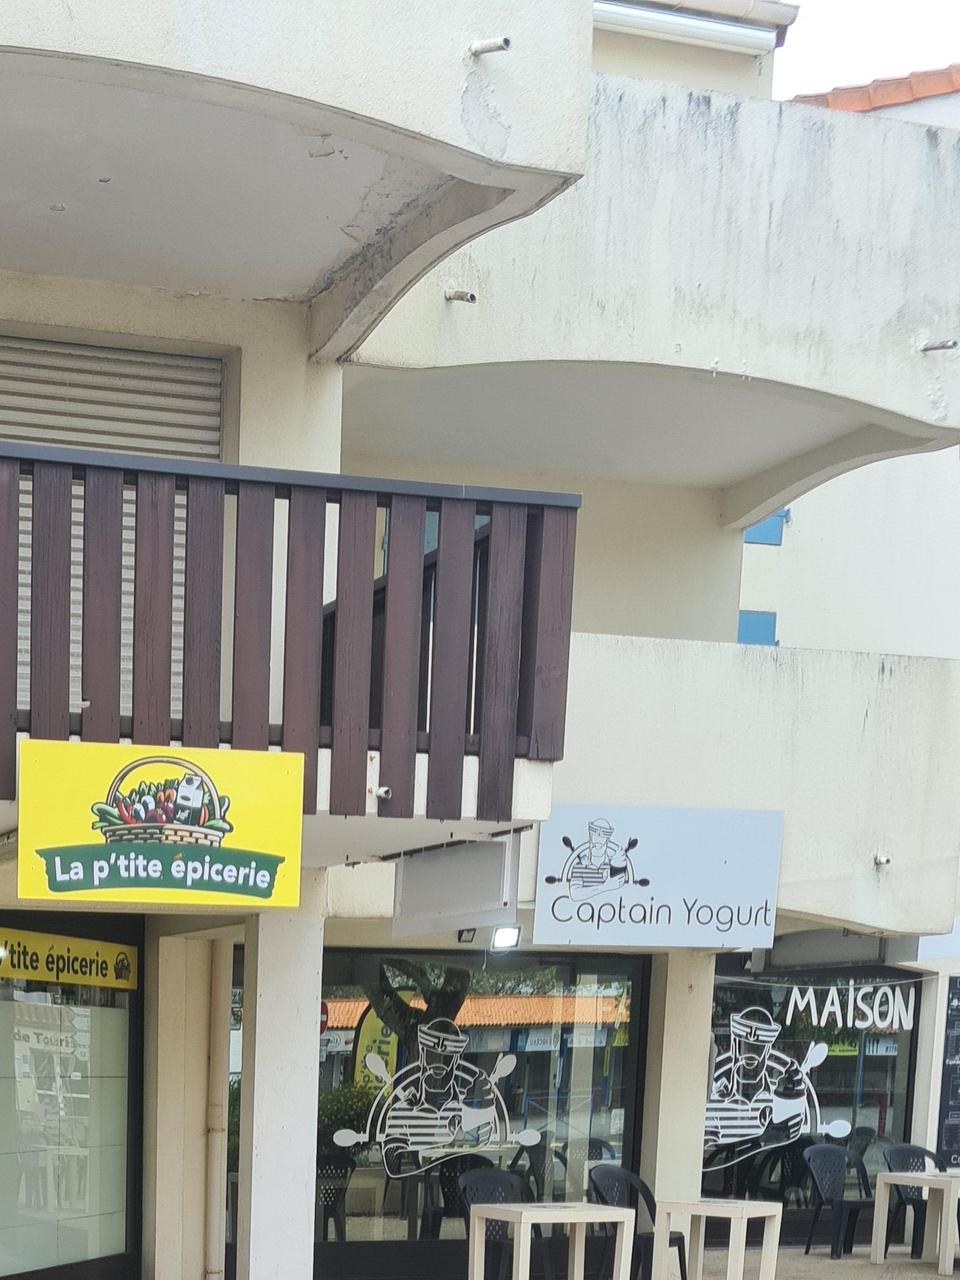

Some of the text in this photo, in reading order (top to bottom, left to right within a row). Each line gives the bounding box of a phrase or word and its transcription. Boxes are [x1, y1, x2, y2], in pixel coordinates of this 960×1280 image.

[54, 852, 271, 889] La p'tite épicerie
[551, 895, 772, 933] Captain Yogurt
[45, 943, 109, 981] épicerie
[785, 978, 916, 1031] MAISON
